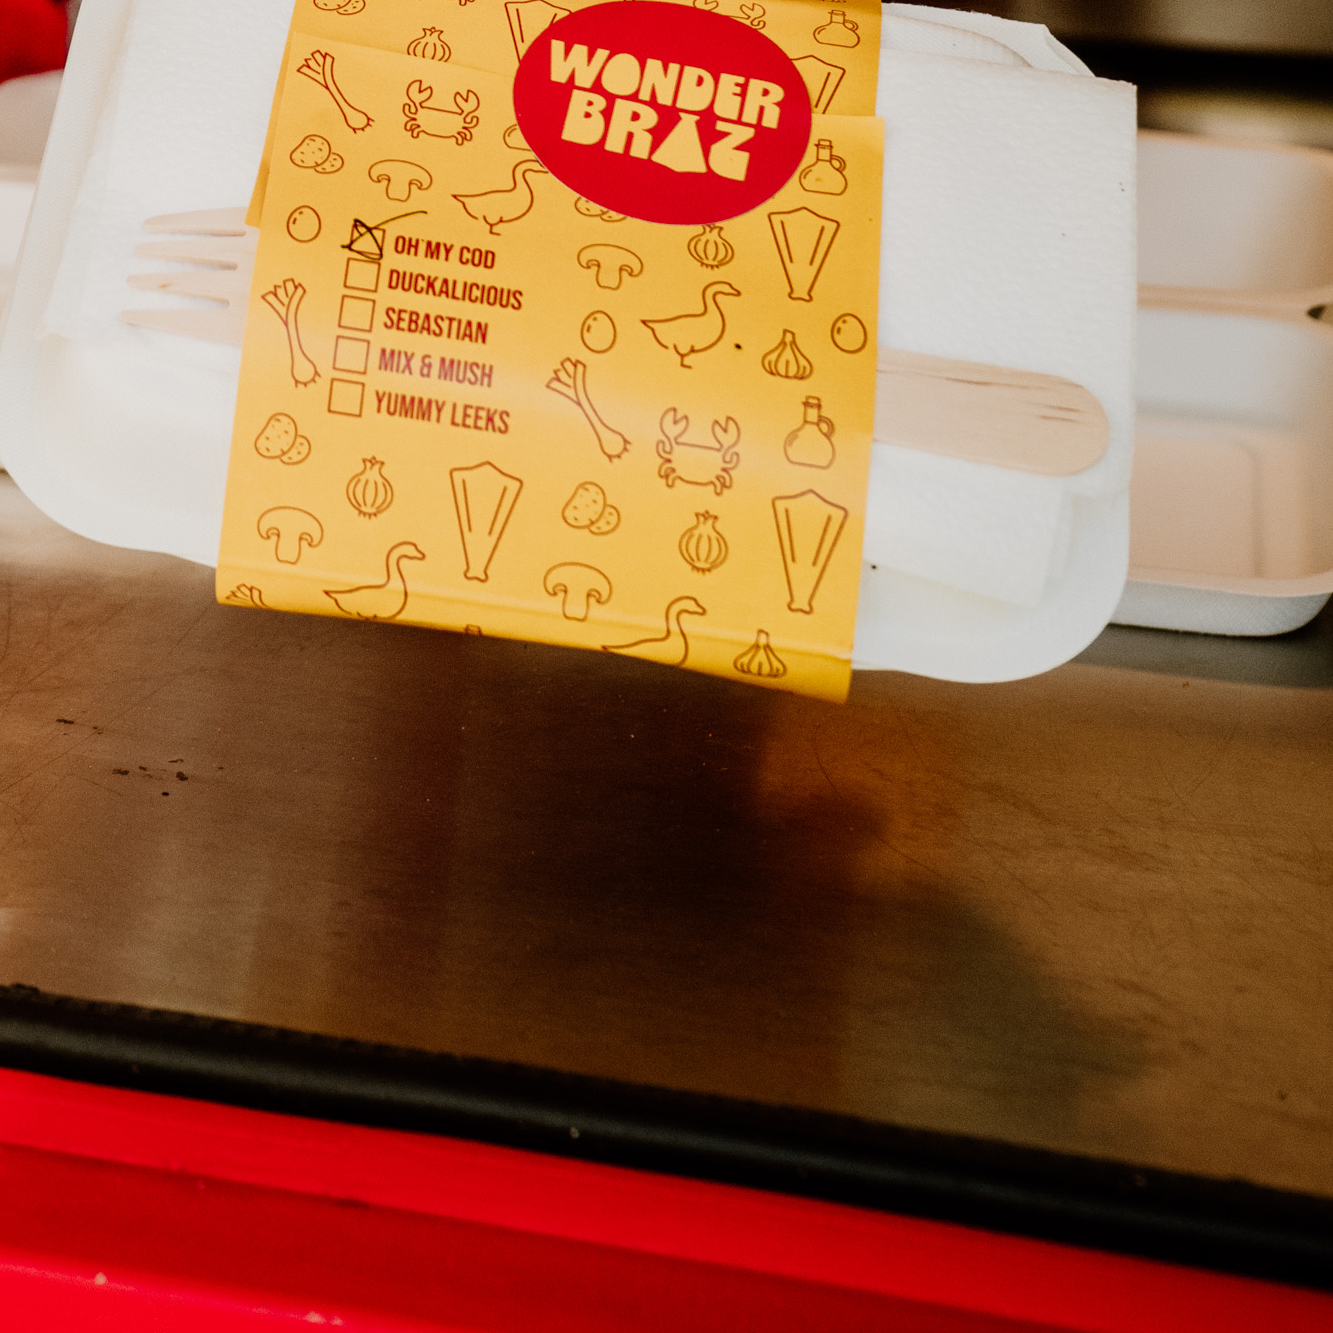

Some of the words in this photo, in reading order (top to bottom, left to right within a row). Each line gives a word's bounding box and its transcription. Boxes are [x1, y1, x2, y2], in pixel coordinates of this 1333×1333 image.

[550, 39, 785, 129] WONDER
[561, 89, 756, 182] BRAZ
[393, 235, 419, 256] OH
[424, 240, 454, 262] MY
[458, 246, 496, 269] COD
[387, 269, 524, 311] DUCKALICIOUS
[383, 306, 489, 345] SEBASTIAN
[378, 347, 415, 376] MIX
[419, 354, 433, 379] &
[437, 356, 494, 389] MUSH
[374, 389, 446, 424] YUMMY
[449, 401, 511, 436] LEEKS
